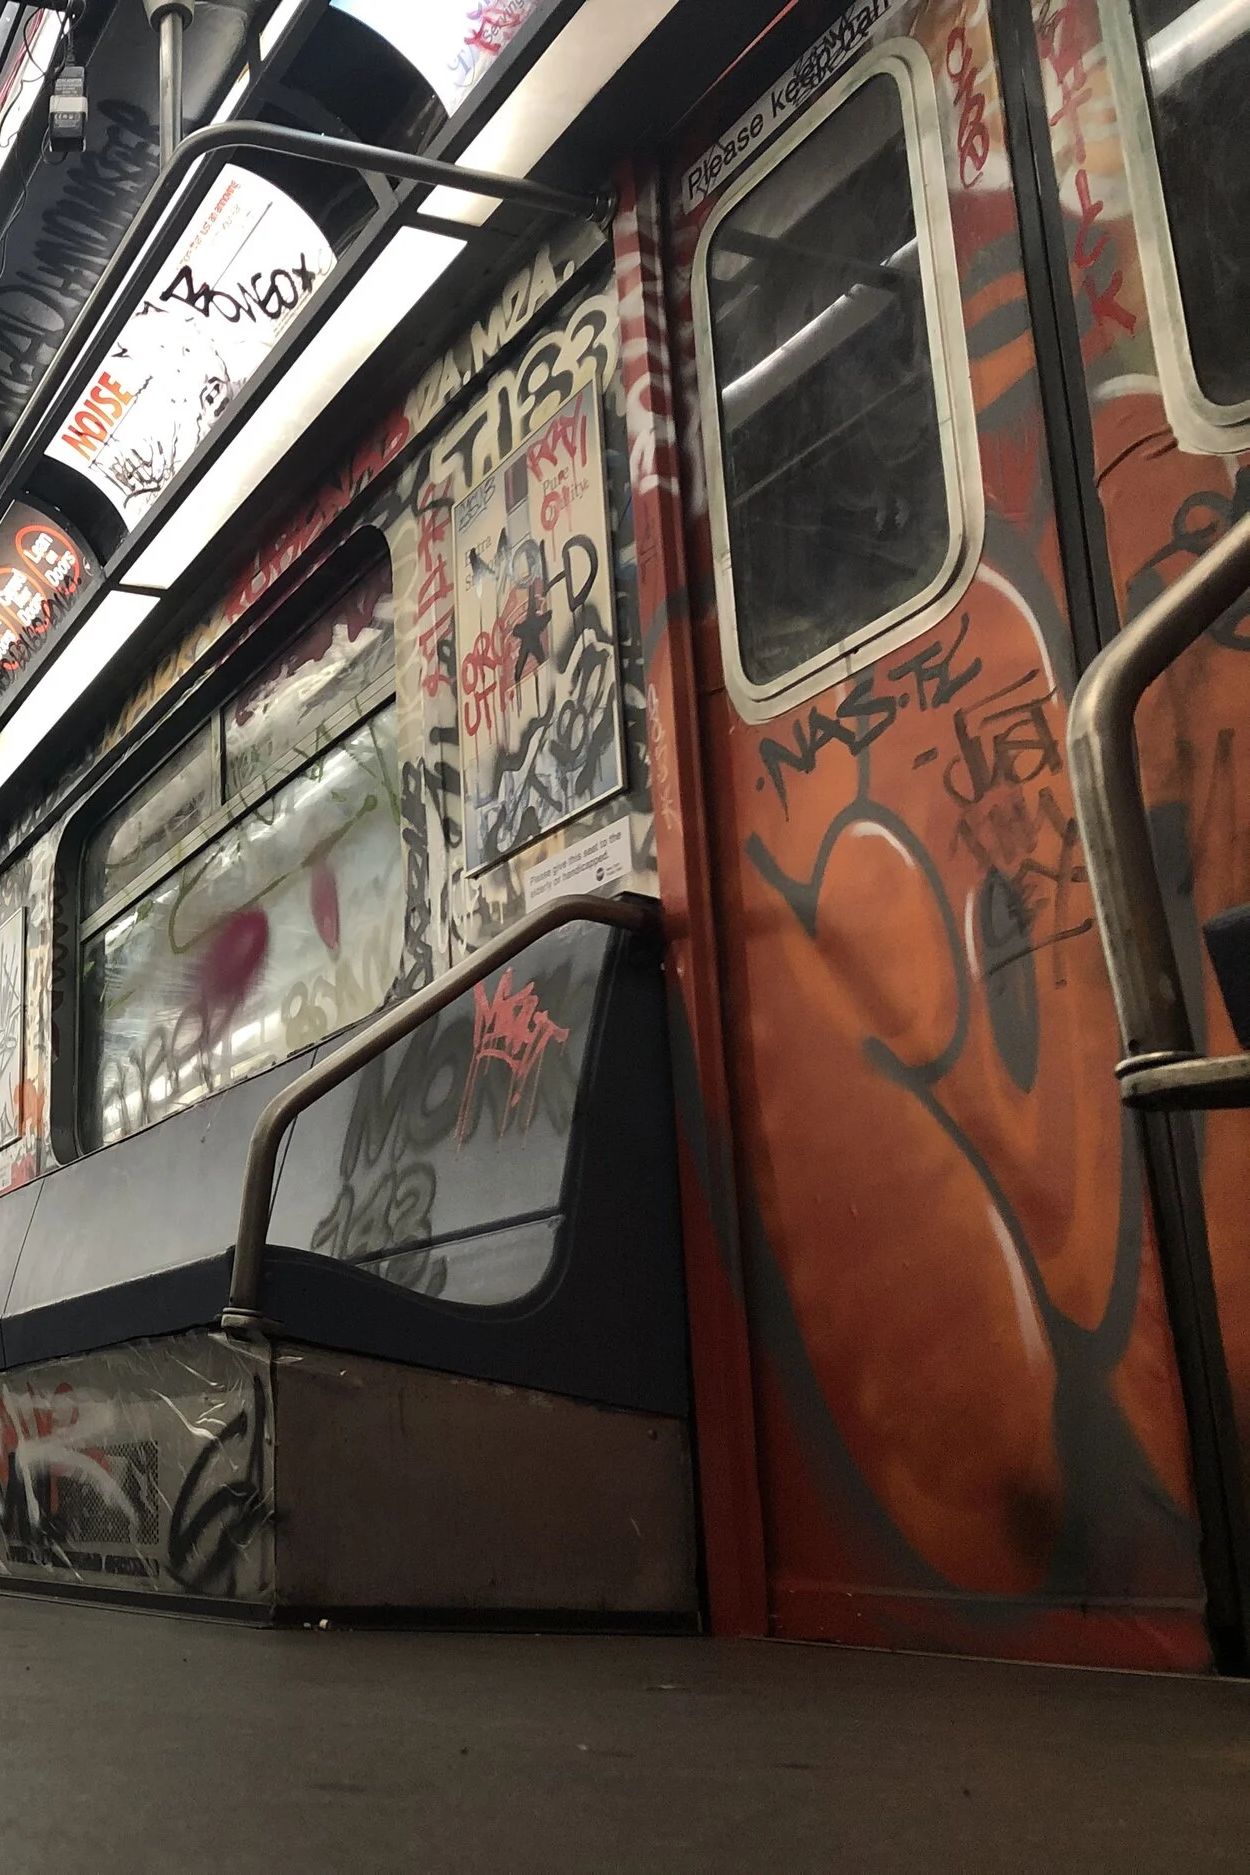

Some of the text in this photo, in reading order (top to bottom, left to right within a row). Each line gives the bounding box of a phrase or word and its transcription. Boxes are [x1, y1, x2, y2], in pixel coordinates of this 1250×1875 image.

[687, 112, 765, 200] Please
[61, 371, 136, 461] NOISE
[23, 532, 53, 564] Lean
[45, 549, 77, 587] Doors
[17, 592, 44, 627] Doors
[583, 843, 599, 858] seat
[609, 831, 622, 844] the
